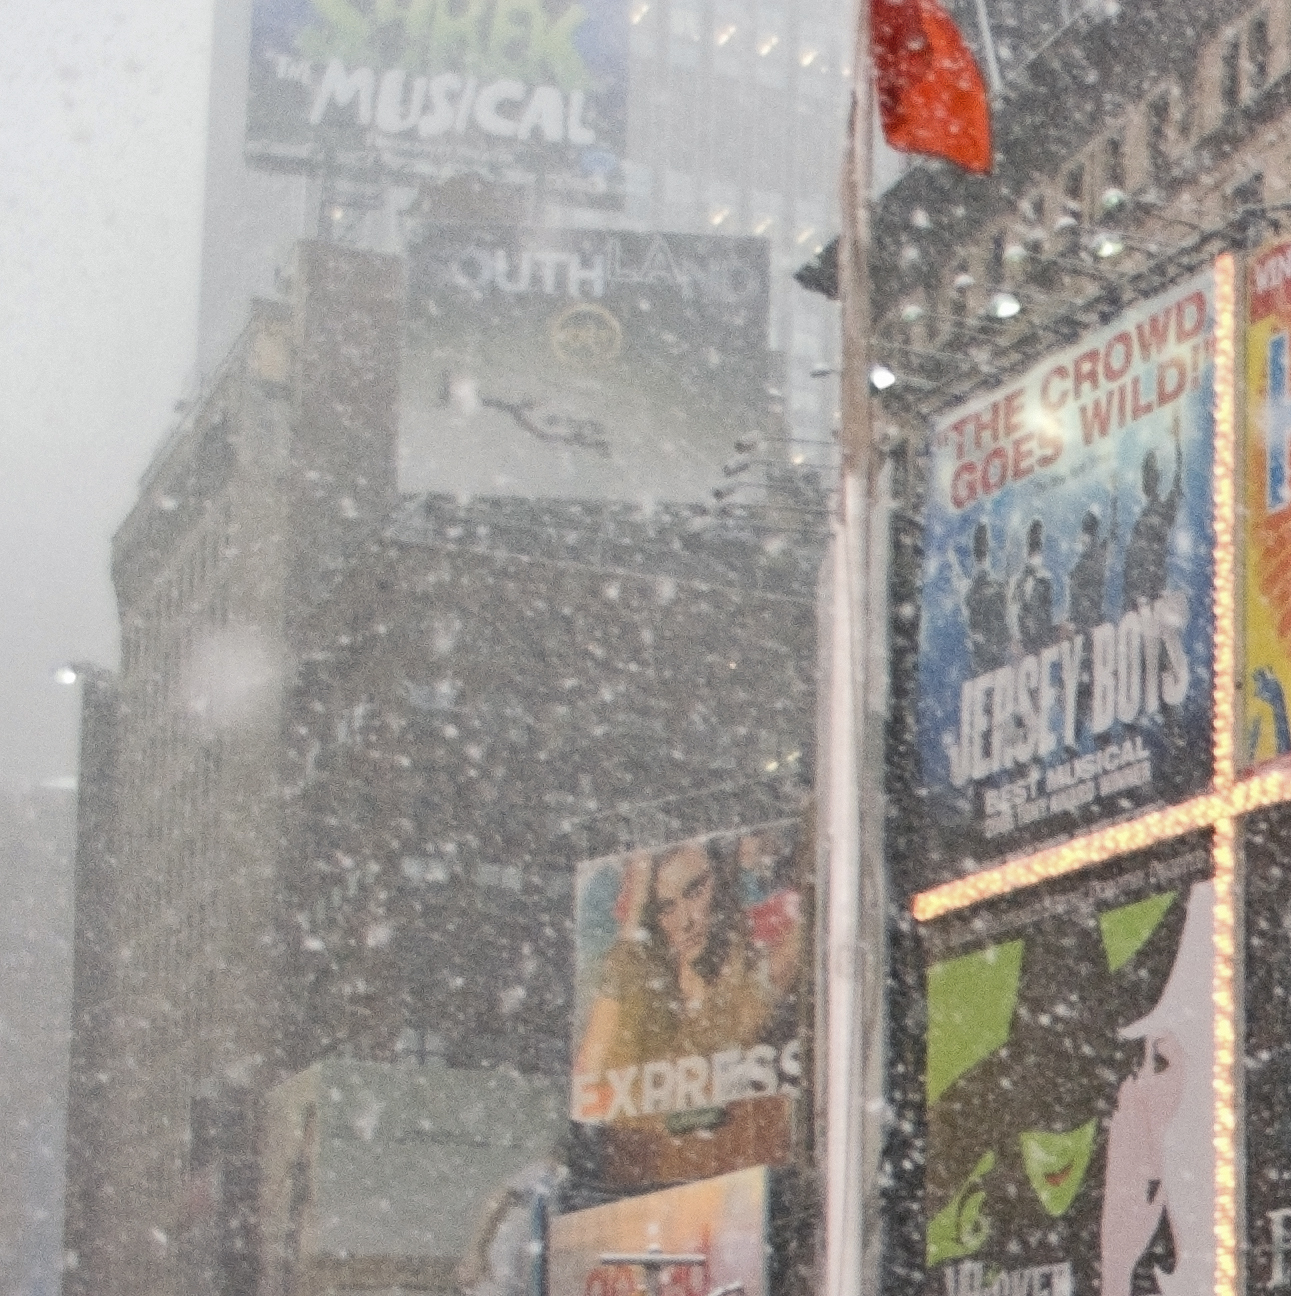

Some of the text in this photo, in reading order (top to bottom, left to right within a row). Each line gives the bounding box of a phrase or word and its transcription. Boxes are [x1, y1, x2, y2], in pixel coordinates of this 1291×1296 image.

[310, 57, 597, 145] MUSICAL
[1040, 290, 1207, 414] CROWD
[951, 431, 1064, 510] GOES
[947, 600, 1190, 787] JERSEY BOYS
[572, 1039, 800, 1124] EXPRESS
